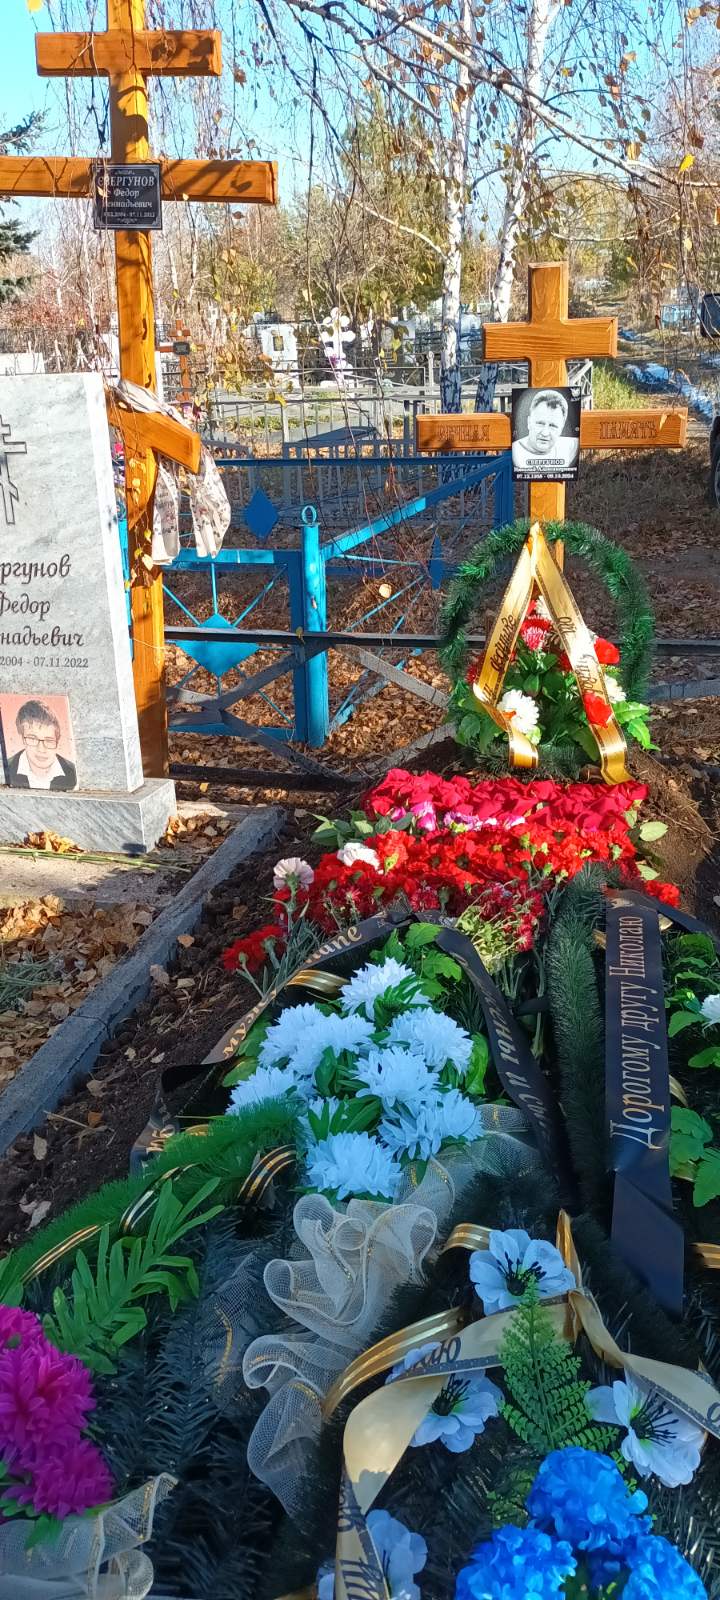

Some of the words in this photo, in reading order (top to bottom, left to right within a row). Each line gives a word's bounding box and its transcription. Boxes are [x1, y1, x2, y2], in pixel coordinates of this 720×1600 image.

[113, 188, 140, 198] Федор
[599, 420, 657, 440] ПАМЯТЬ
[0, 553, 72, 586] ргунов
[0, 625, 84, 647] надьевич
[0, 656, 23, 667] 2004
[33, 656, 89, 668] 07.11.2022
[608, 916, 646, 979] Николаю
[620, 982, 661, 1033] другу
[609, 1033, 665, 1150] Дорогому
